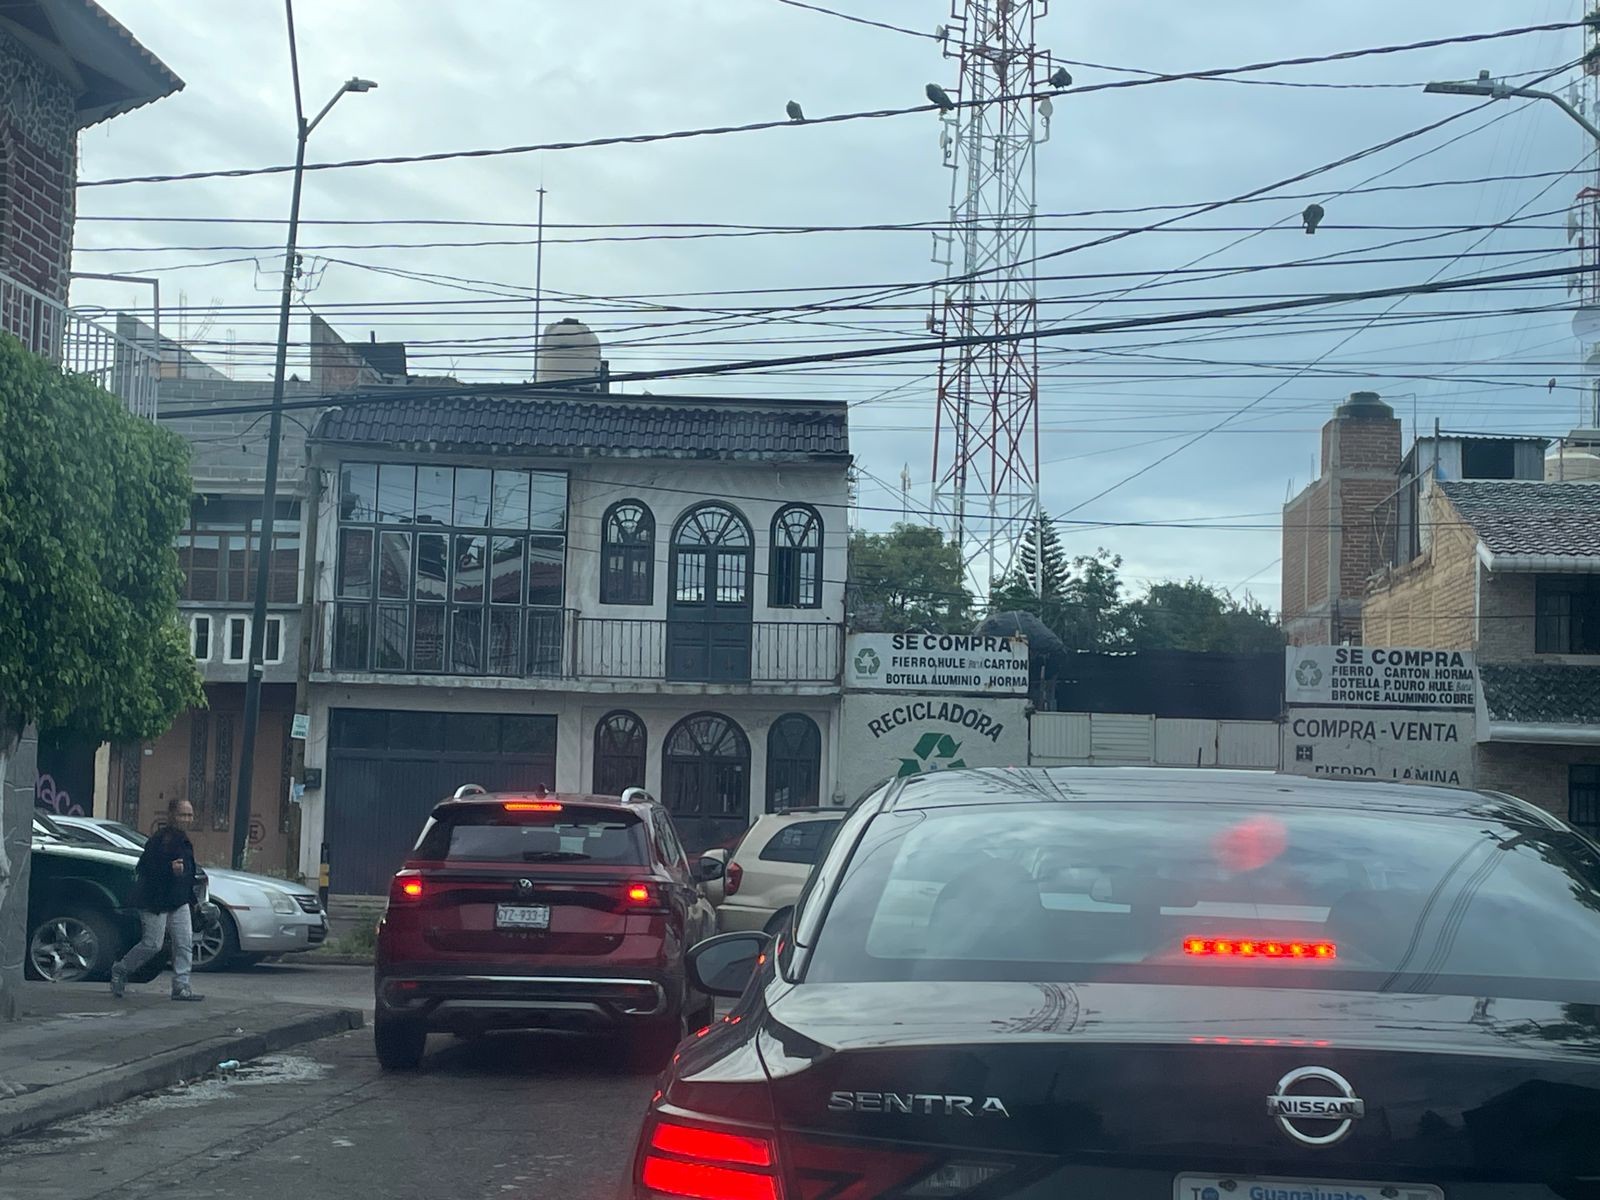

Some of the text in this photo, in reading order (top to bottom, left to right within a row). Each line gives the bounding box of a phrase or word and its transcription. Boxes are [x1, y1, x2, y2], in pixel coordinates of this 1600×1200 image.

[892, 634, 1012, 653] SE COMPRA
[892, 657, 936, 668] FIERRO
[937, 657, 966, 669] HULE
[984, 658, 1028, 671] CARTON
[1335, 648, 1464, 667] SE COMPRA
[1331, 665, 1474, 680] FIERRO CARTON HORMA
[886, 673, 1028, 688] BOTELLA ALUMINIO HORMA
[1331, 678, 1380, 689] BOTELLA
[1428, 681, 1454, 692] HULE
[1331, 690, 1474, 704] BRONCE ALUMINIO COBRE
[867, 701, 1005, 743] RECICLADORA
[1293, 719, 1376, 740] COMPRA
[1390, 721, 1458, 742] VENTA
[828, 1091, 1010, 1117] SENTRA
[1276, 1100, 1355, 1115] NISSAN
